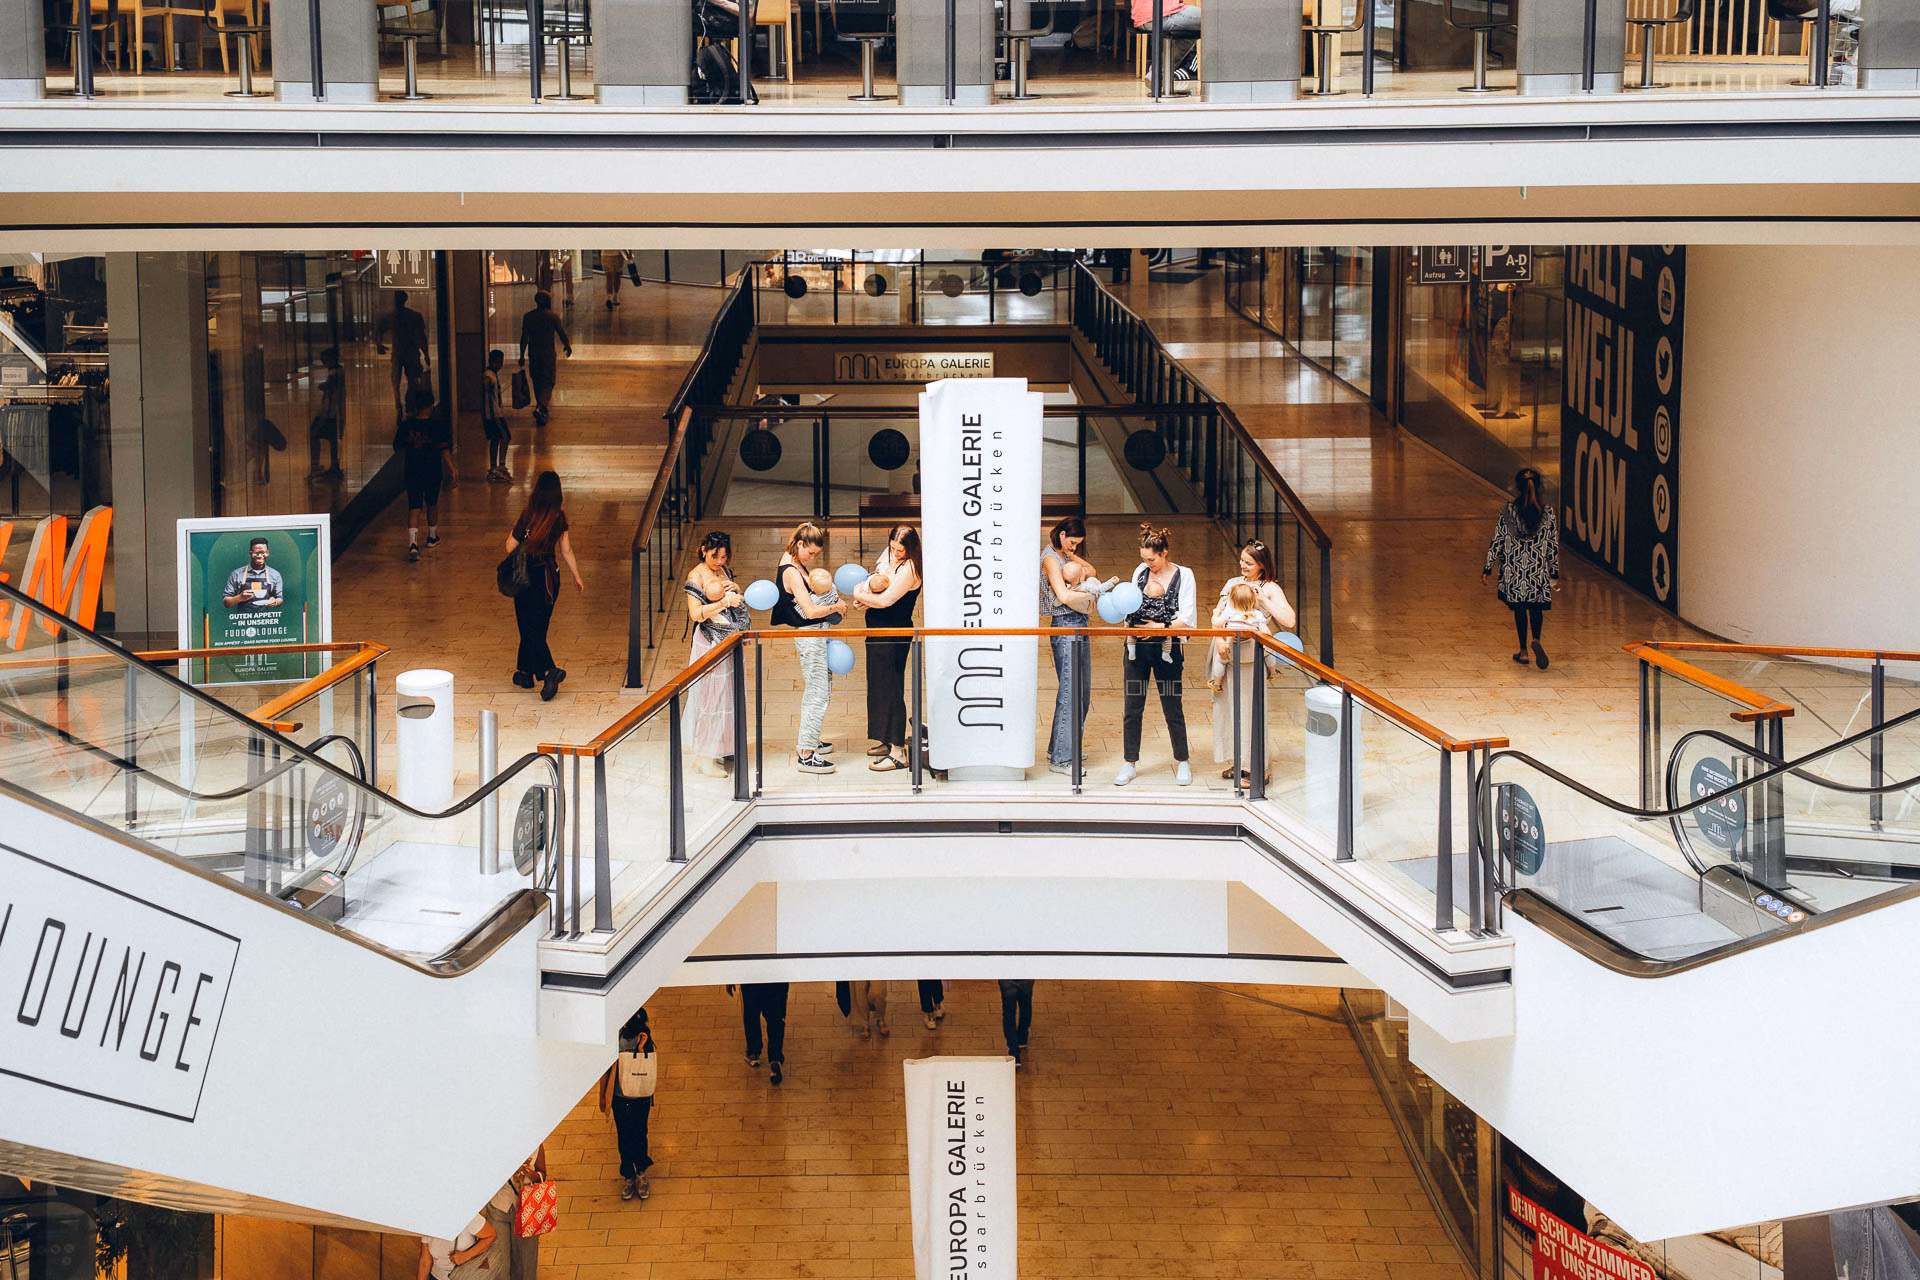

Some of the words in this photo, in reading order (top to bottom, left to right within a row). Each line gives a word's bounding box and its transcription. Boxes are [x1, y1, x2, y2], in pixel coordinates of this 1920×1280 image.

[1505, 254, 1527, 266] A-D
[885, 358, 935, 369] EUROPA
[940, 358, 991, 369] GALERIE
[894, 371, 983, 379] saarbrücken
[962, 413, 982, 517] GALERIE
[1565, 431, 1627, 575] .COM
[990, 431, 1003, 615] saarbrücken
[246, 618, 279, 626] UNSERER
[253, 611, 282, 619] APPETIT
[963, 529, 982, 628] EUROPA
[224, 629, 245, 637] FOOD
[256, 626, 287, 636] LOUNGE
[947, 1081, 967, 1175] GALERIE
[973, 1096, 987, 1269] saarbrücken
[949, 1187, 967, 1280] EUROPA
[1511, 1191, 1537, 1227] DEIN
[1540, 1212, 1651, 1280] SCHLAFZIMMER
[1538, 1233, 1557, 1261] IST
